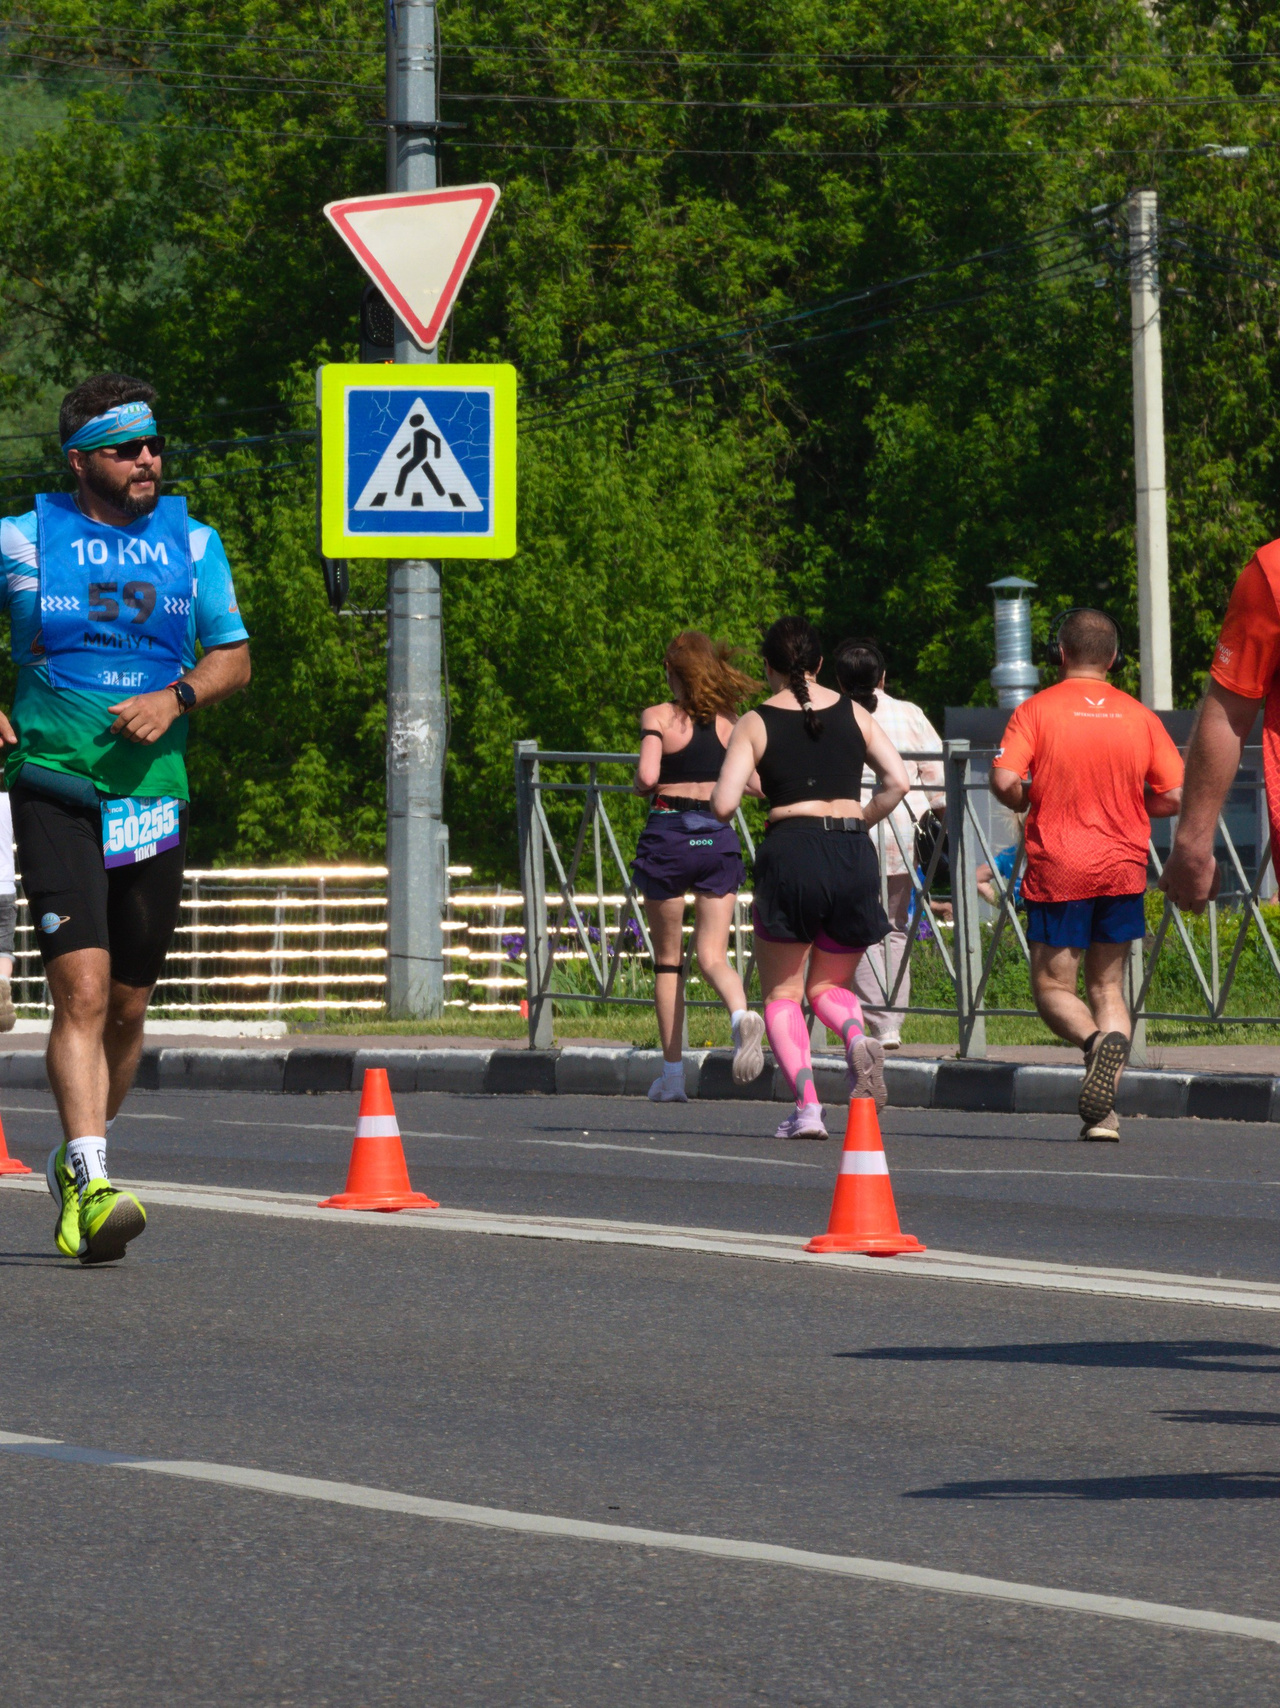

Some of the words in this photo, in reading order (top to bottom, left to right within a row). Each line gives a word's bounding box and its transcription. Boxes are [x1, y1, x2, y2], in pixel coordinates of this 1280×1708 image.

[71, 538, 108, 566] 10
[117, 538, 169, 566] КМ
[87, 580, 157, 625] 59
[83, 631, 158, 650] МИНУТ
[108, 802, 176, 852] 50255
